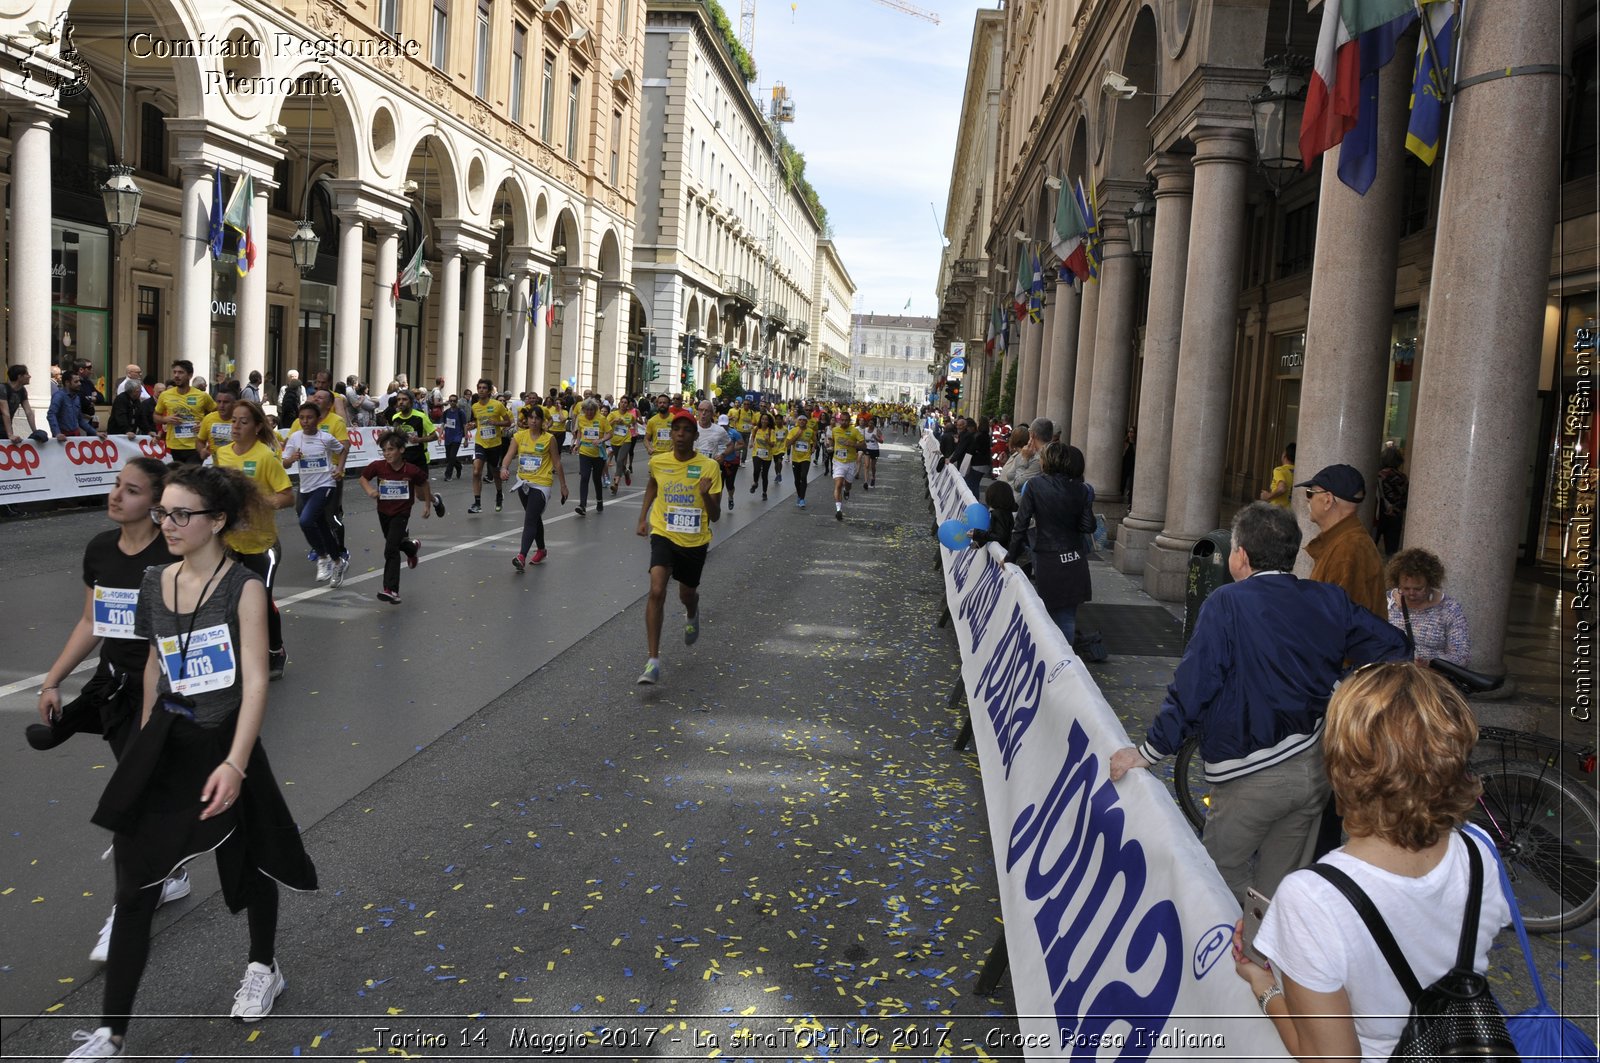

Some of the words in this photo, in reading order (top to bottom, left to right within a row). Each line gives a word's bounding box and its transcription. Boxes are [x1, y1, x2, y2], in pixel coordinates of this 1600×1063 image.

[211, 300, 237, 316] ONER
[1564, 394, 1579, 436] KORS
[65, 440, 118, 469] coop
[1554, 441, 1575, 509] MICHAEL
[664, 494, 695, 503] TORINO
[673, 514, 695, 526] 8964
[1060, 551, 1080, 563] USA
[108, 609, 136, 625] 4710
[186, 655, 213, 678] 4713
